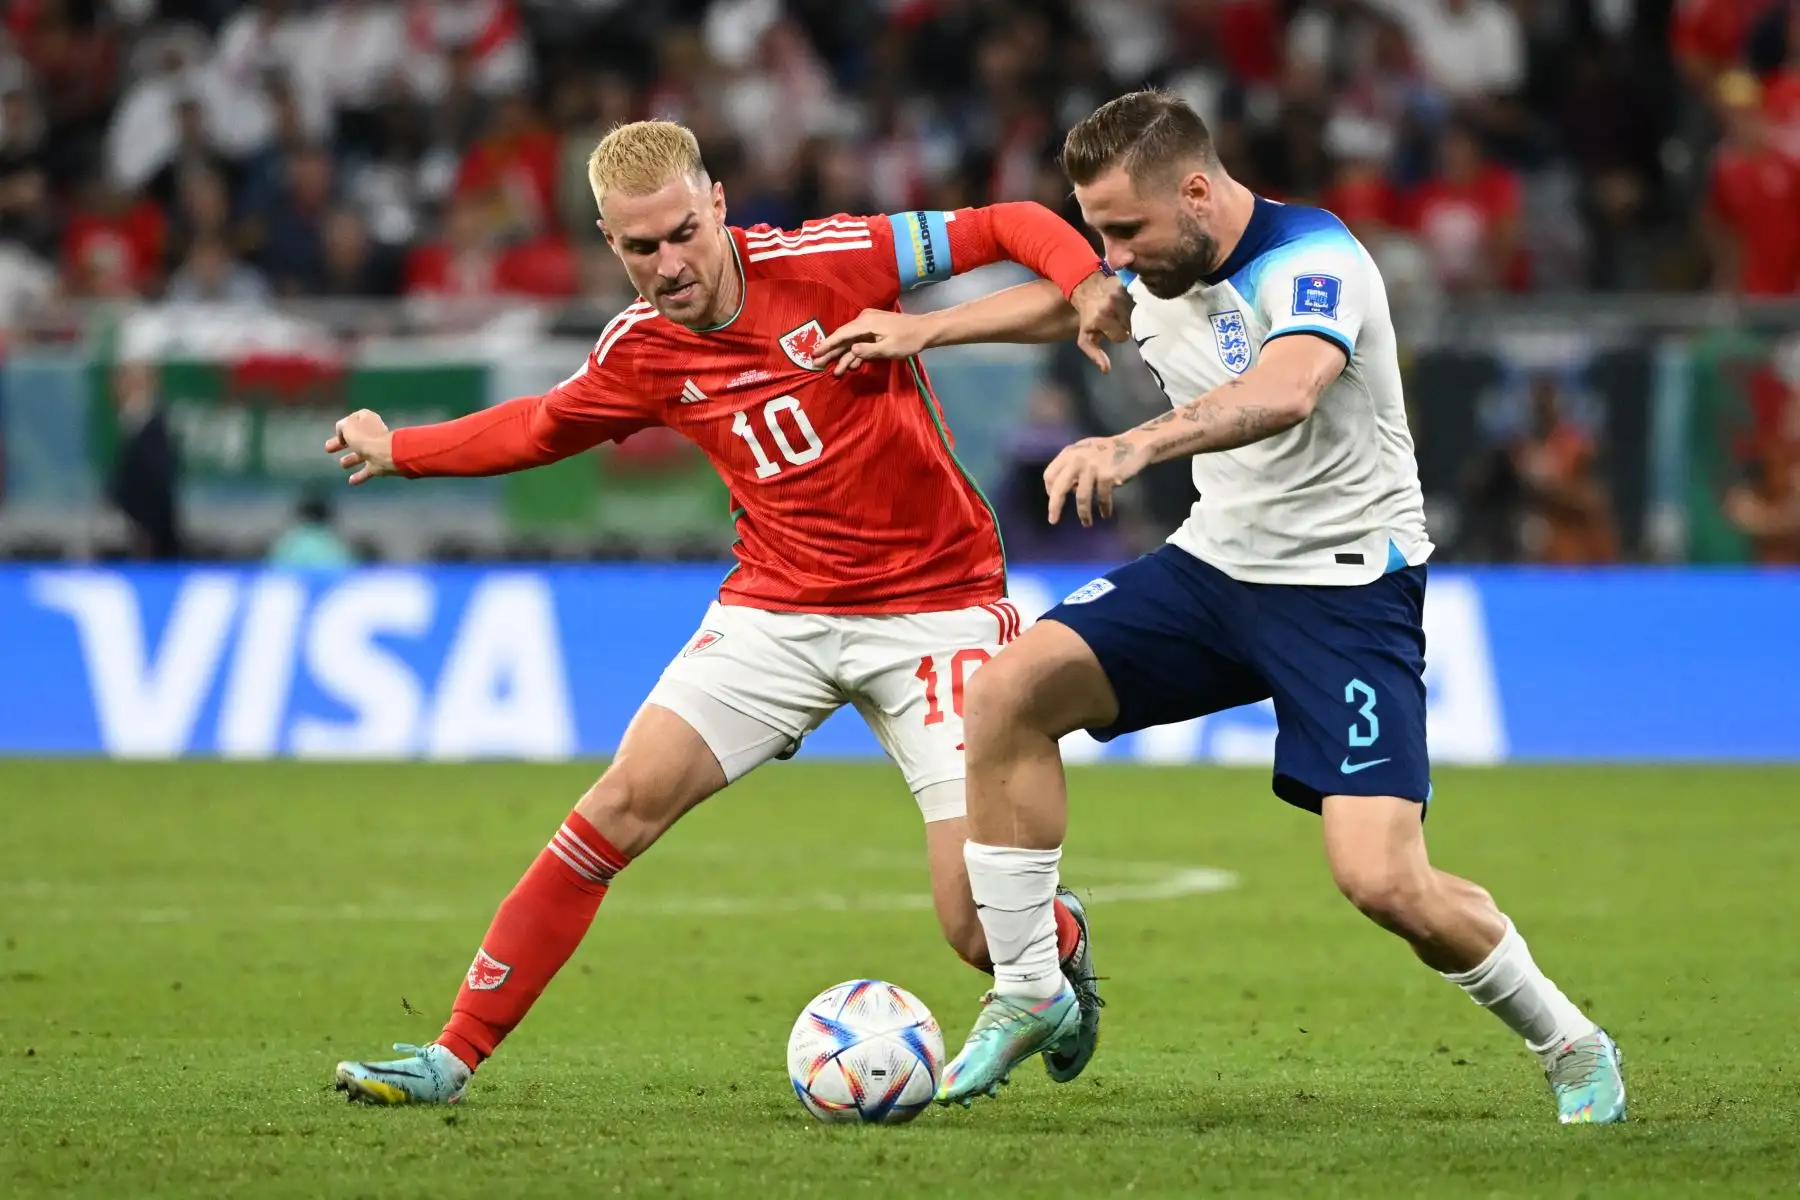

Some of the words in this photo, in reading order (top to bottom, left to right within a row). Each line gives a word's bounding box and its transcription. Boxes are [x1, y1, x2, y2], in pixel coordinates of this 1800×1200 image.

[731, 395, 824, 479] 10
[30, 572, 577, 760] VISA
[1345, 678, 1380, 746] 3
